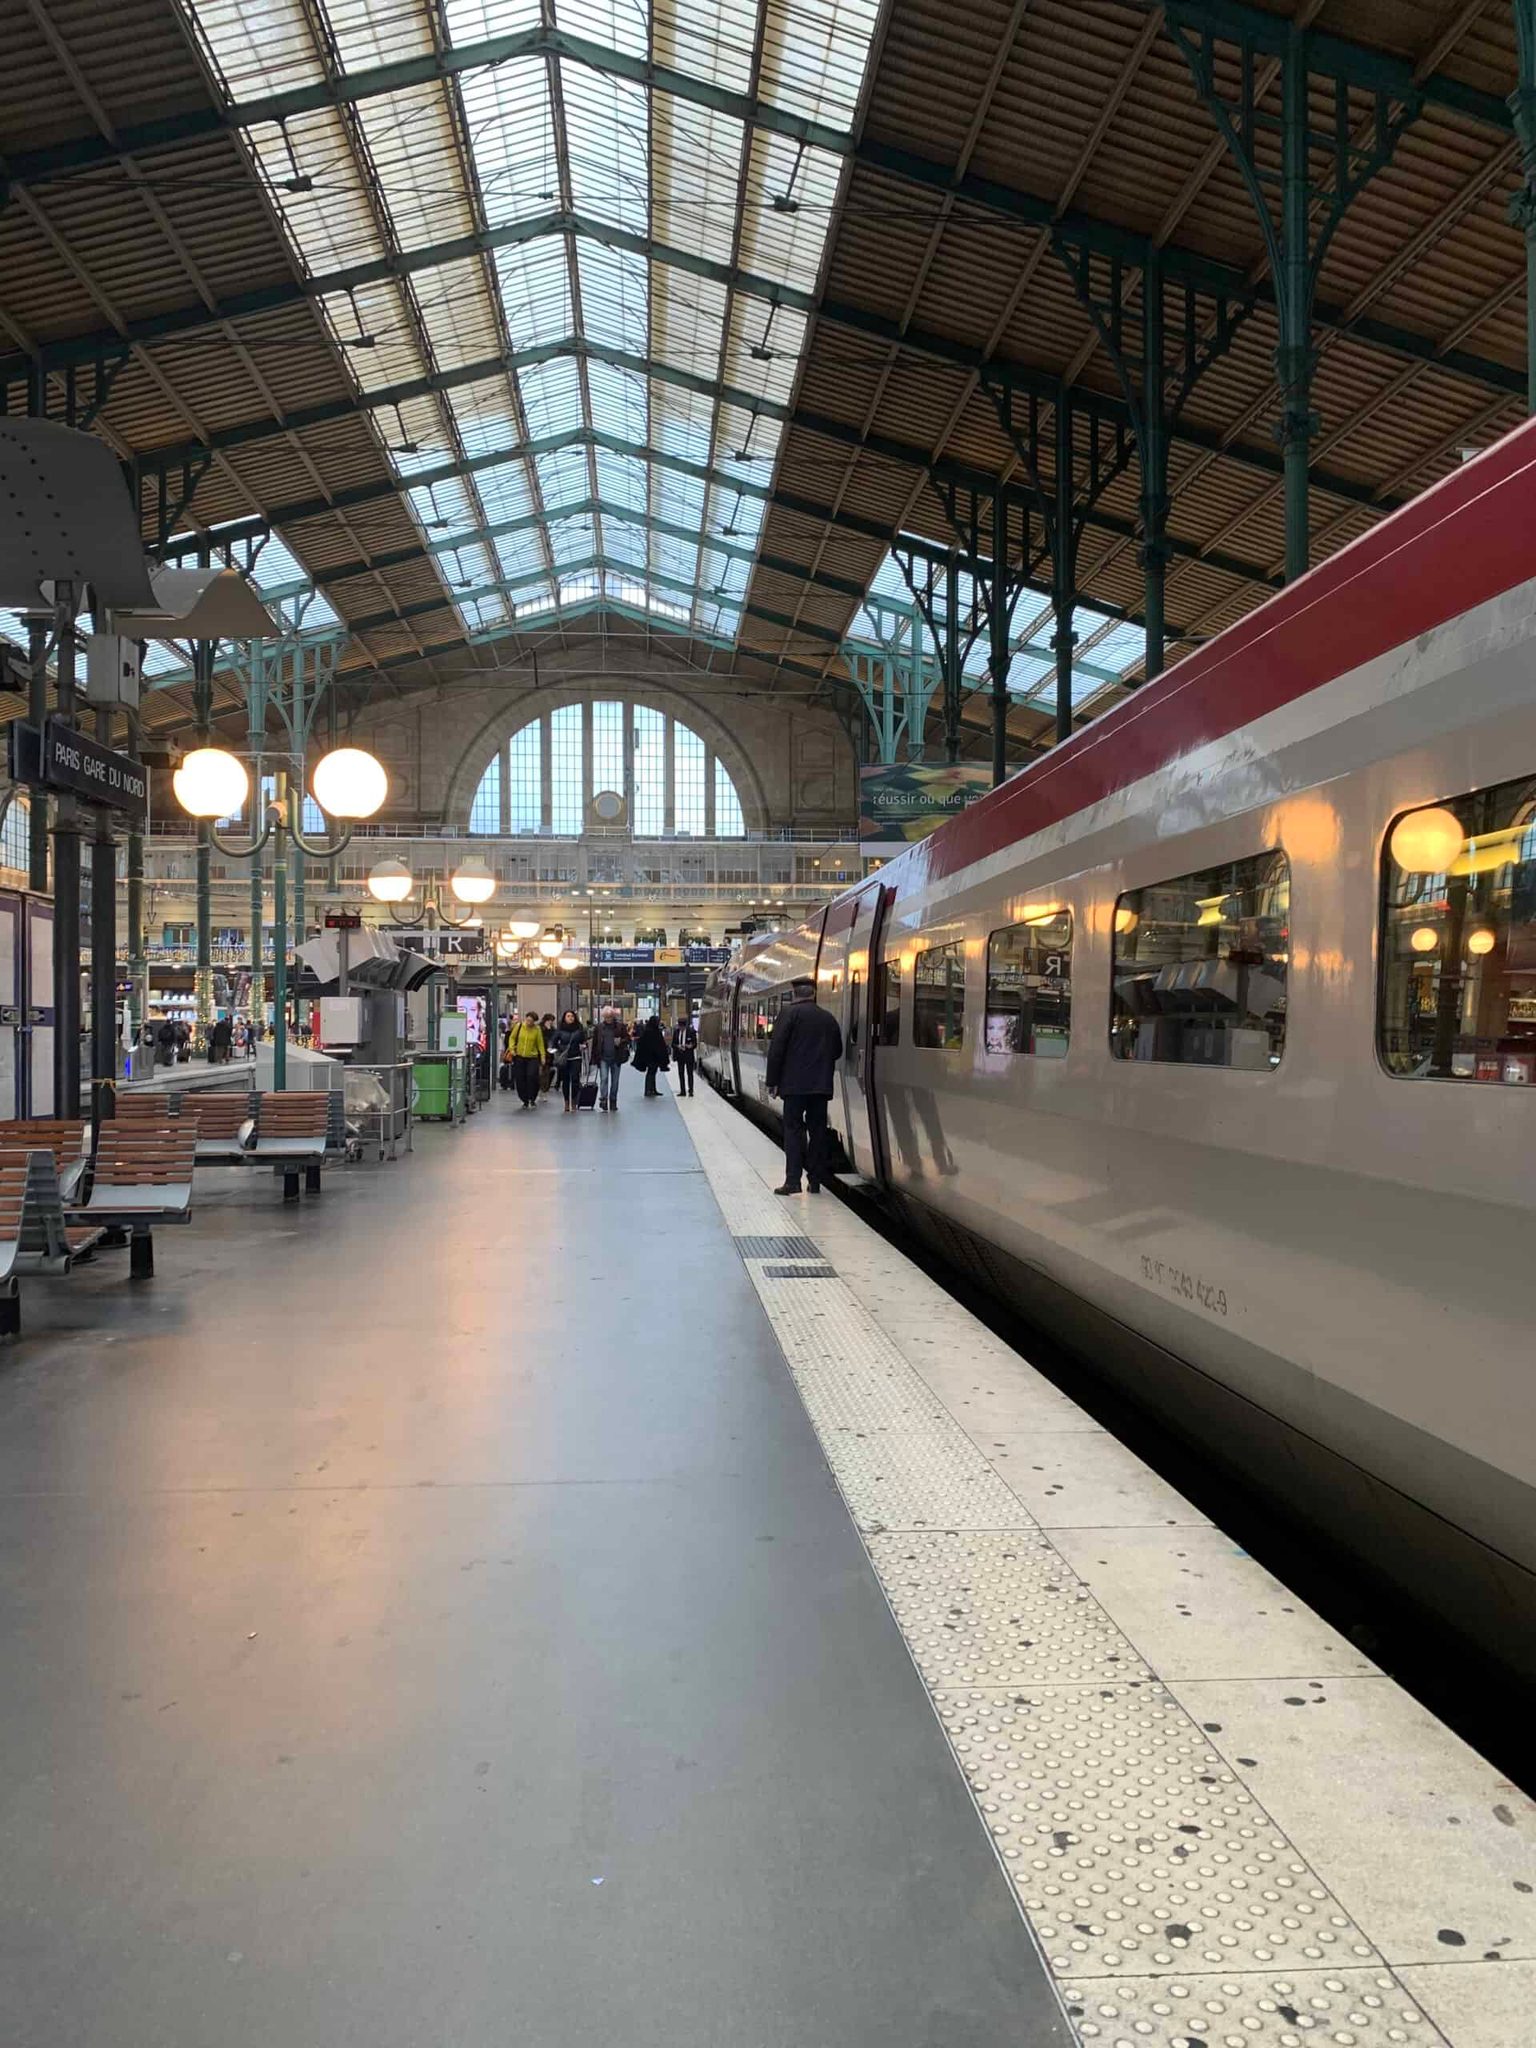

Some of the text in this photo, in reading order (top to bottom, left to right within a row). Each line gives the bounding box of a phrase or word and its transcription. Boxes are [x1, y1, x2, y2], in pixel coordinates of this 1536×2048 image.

[55, 742, 145, 798] PARIS GARE DU NORD
[872, 792, 916, 805] réussir
[939, 795, 961, 807] que
[448, 936, 463, 952] R
